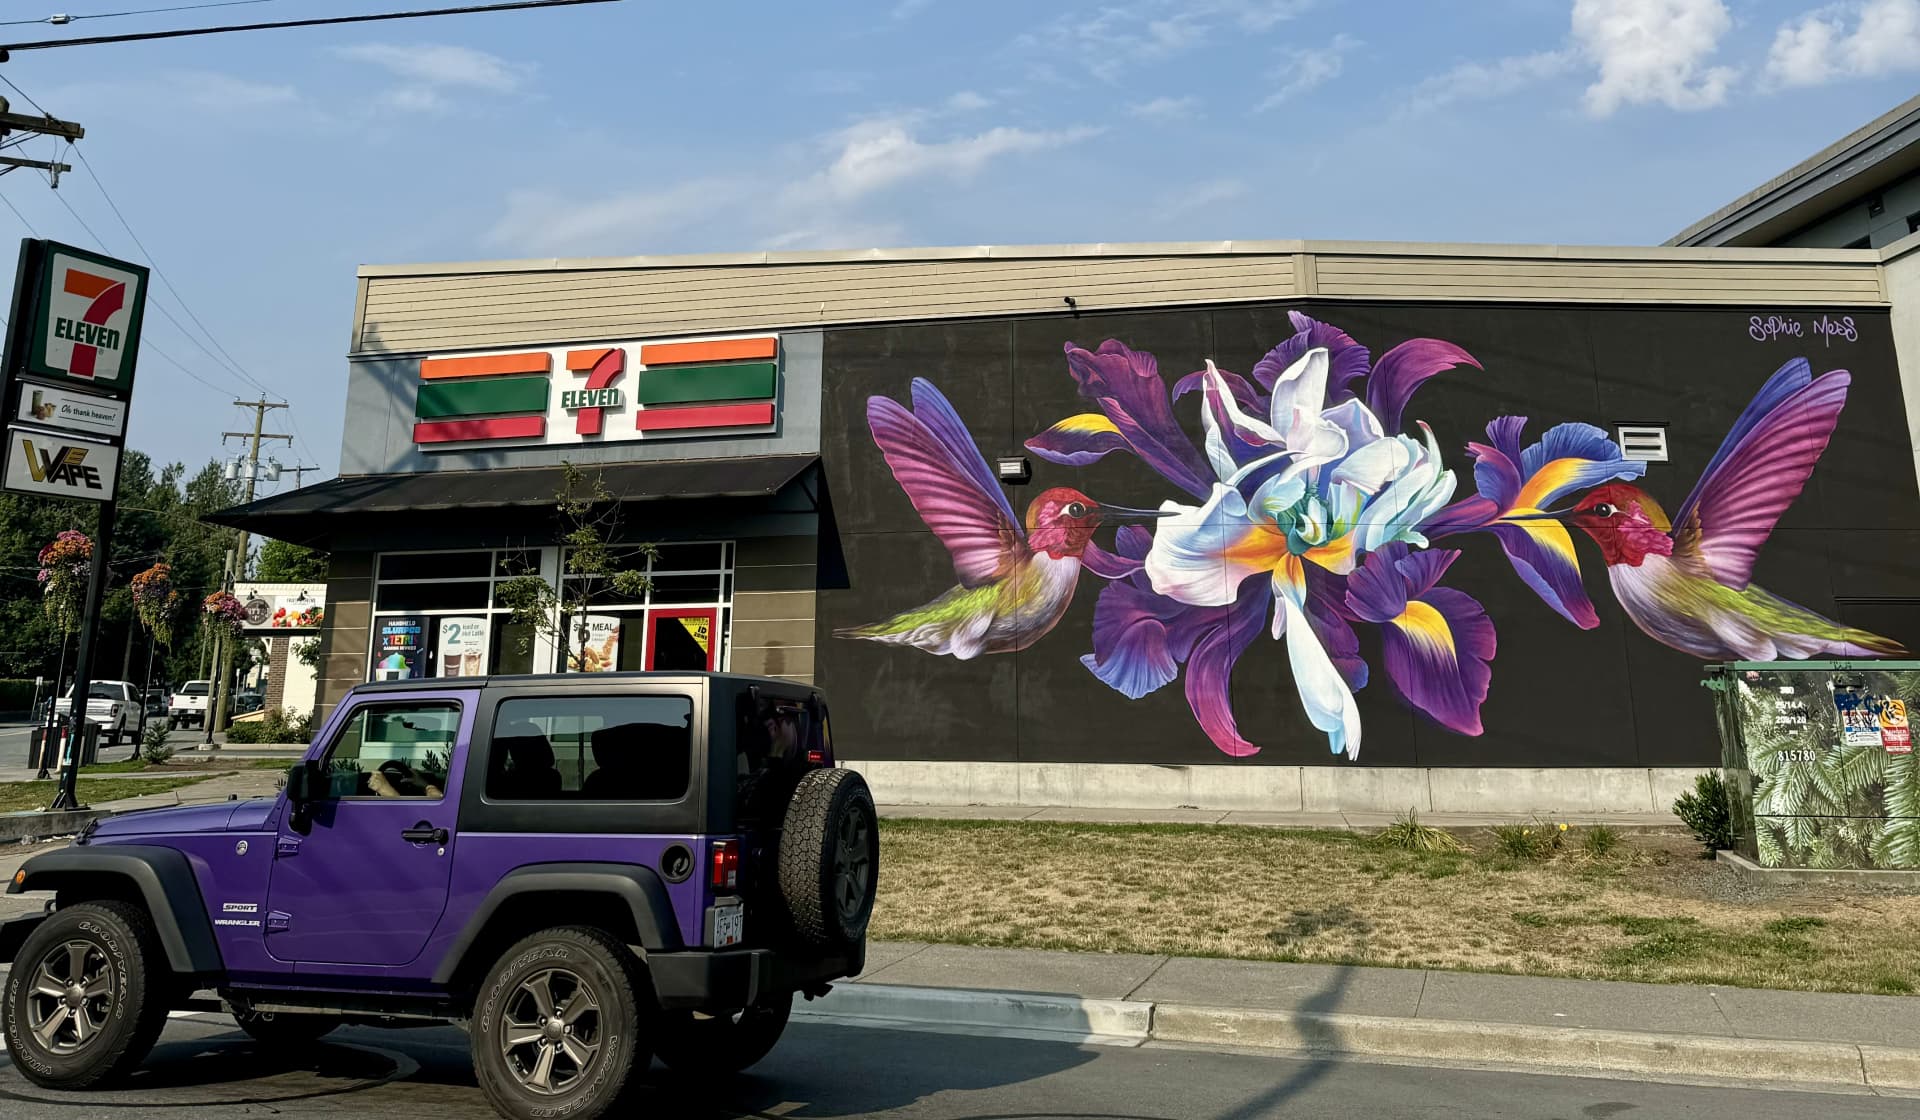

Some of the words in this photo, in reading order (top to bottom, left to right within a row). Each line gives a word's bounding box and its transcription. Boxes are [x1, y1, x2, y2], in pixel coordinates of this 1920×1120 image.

[1749, 316, 1804, 341] Sophie
[61, 404, 72, 413] Oh
[73, 408, 91, 417] thank
[592, 623, 613, 631] MEAL
[1777, 750, 1816, 761] 815780
[214, 919, 261, 927] WRANGLER
